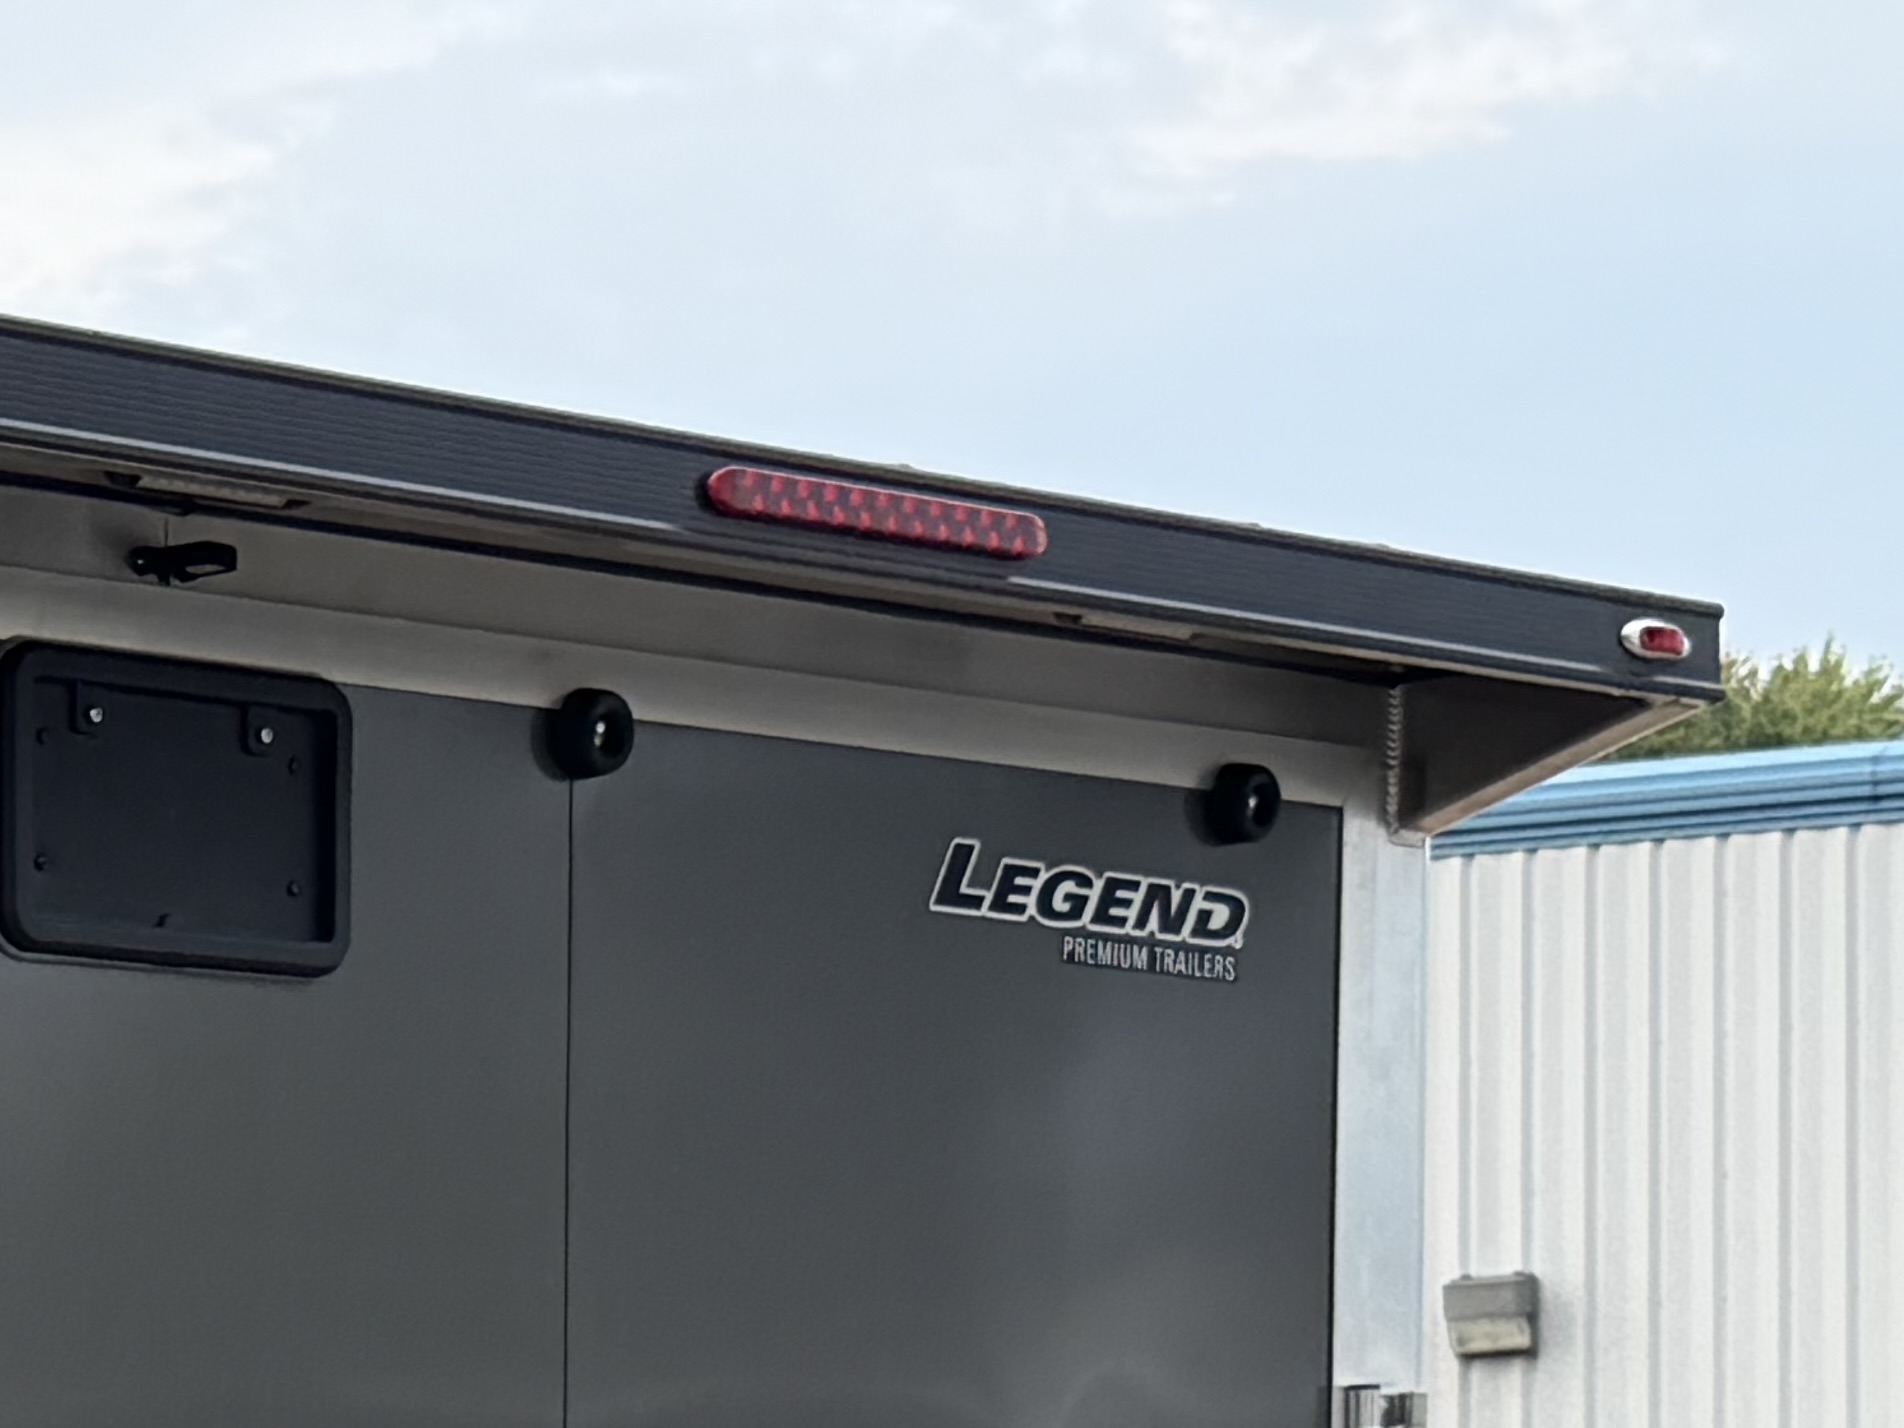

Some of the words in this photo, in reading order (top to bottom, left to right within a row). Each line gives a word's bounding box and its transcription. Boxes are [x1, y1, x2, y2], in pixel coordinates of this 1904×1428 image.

[929, 837, 1249, 947] LEGEND
[1063, 936, 1148, 971] PREMIUM
[1154, 947, 1237, 982] TRAILERS
